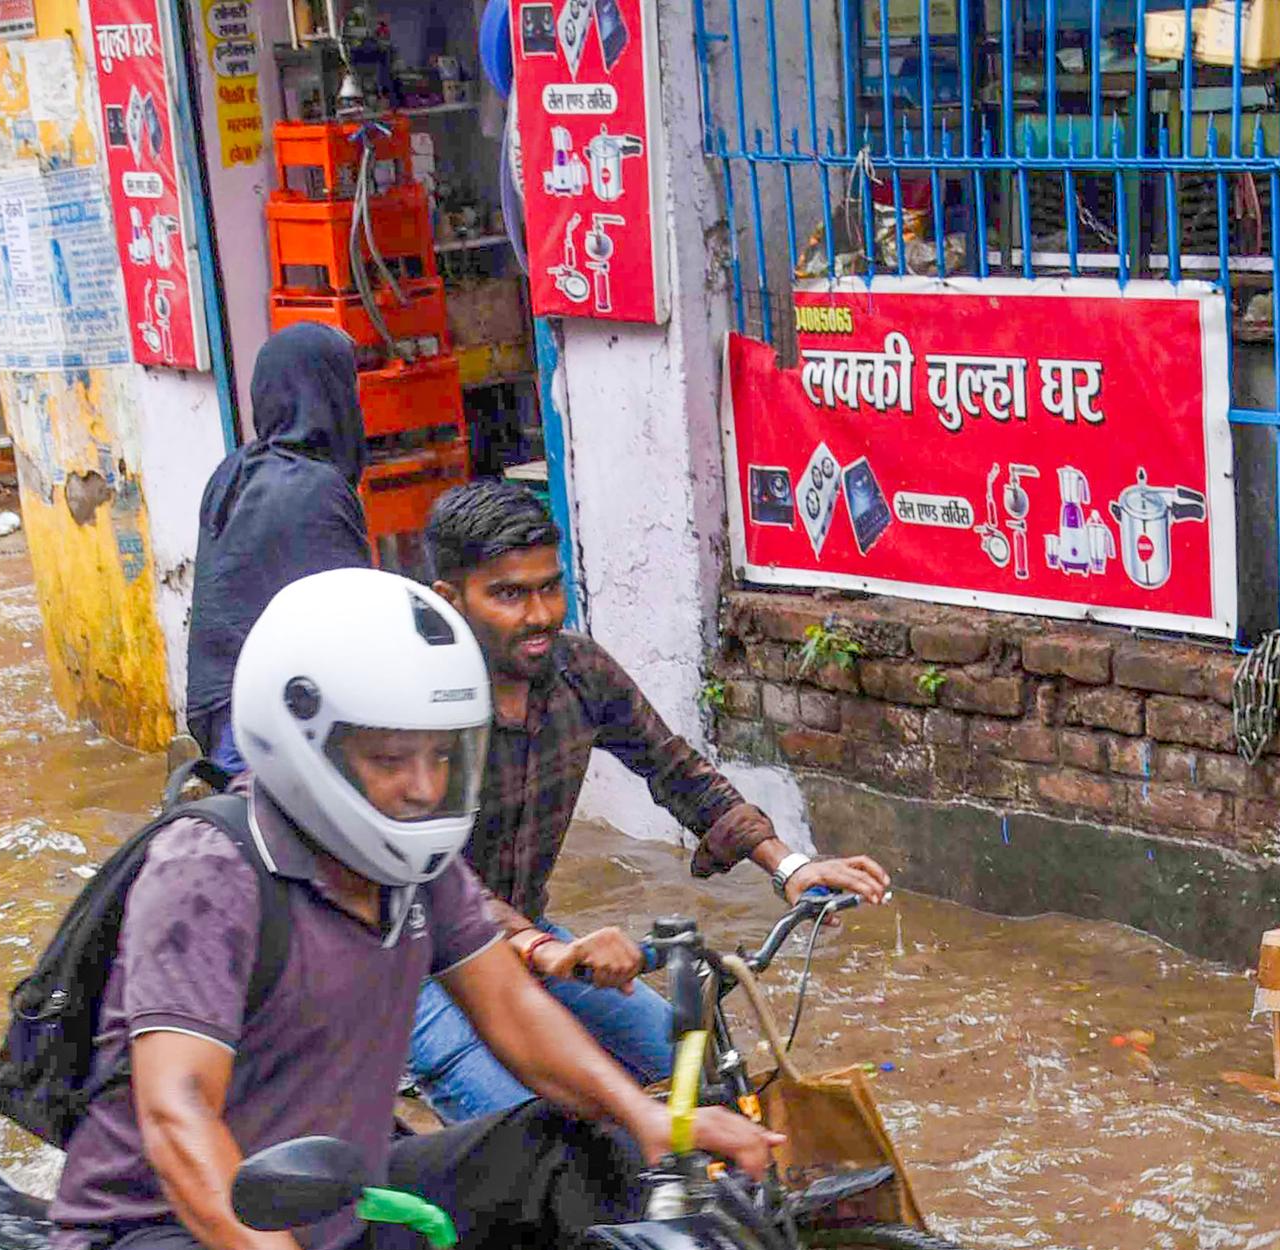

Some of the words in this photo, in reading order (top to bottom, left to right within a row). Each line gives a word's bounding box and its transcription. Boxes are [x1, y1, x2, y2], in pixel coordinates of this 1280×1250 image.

[801, 331, 915, 414] लक्की
[925, 354, 1027, 432] चुल्हा
[1037, 358, 1105, 424] घर
